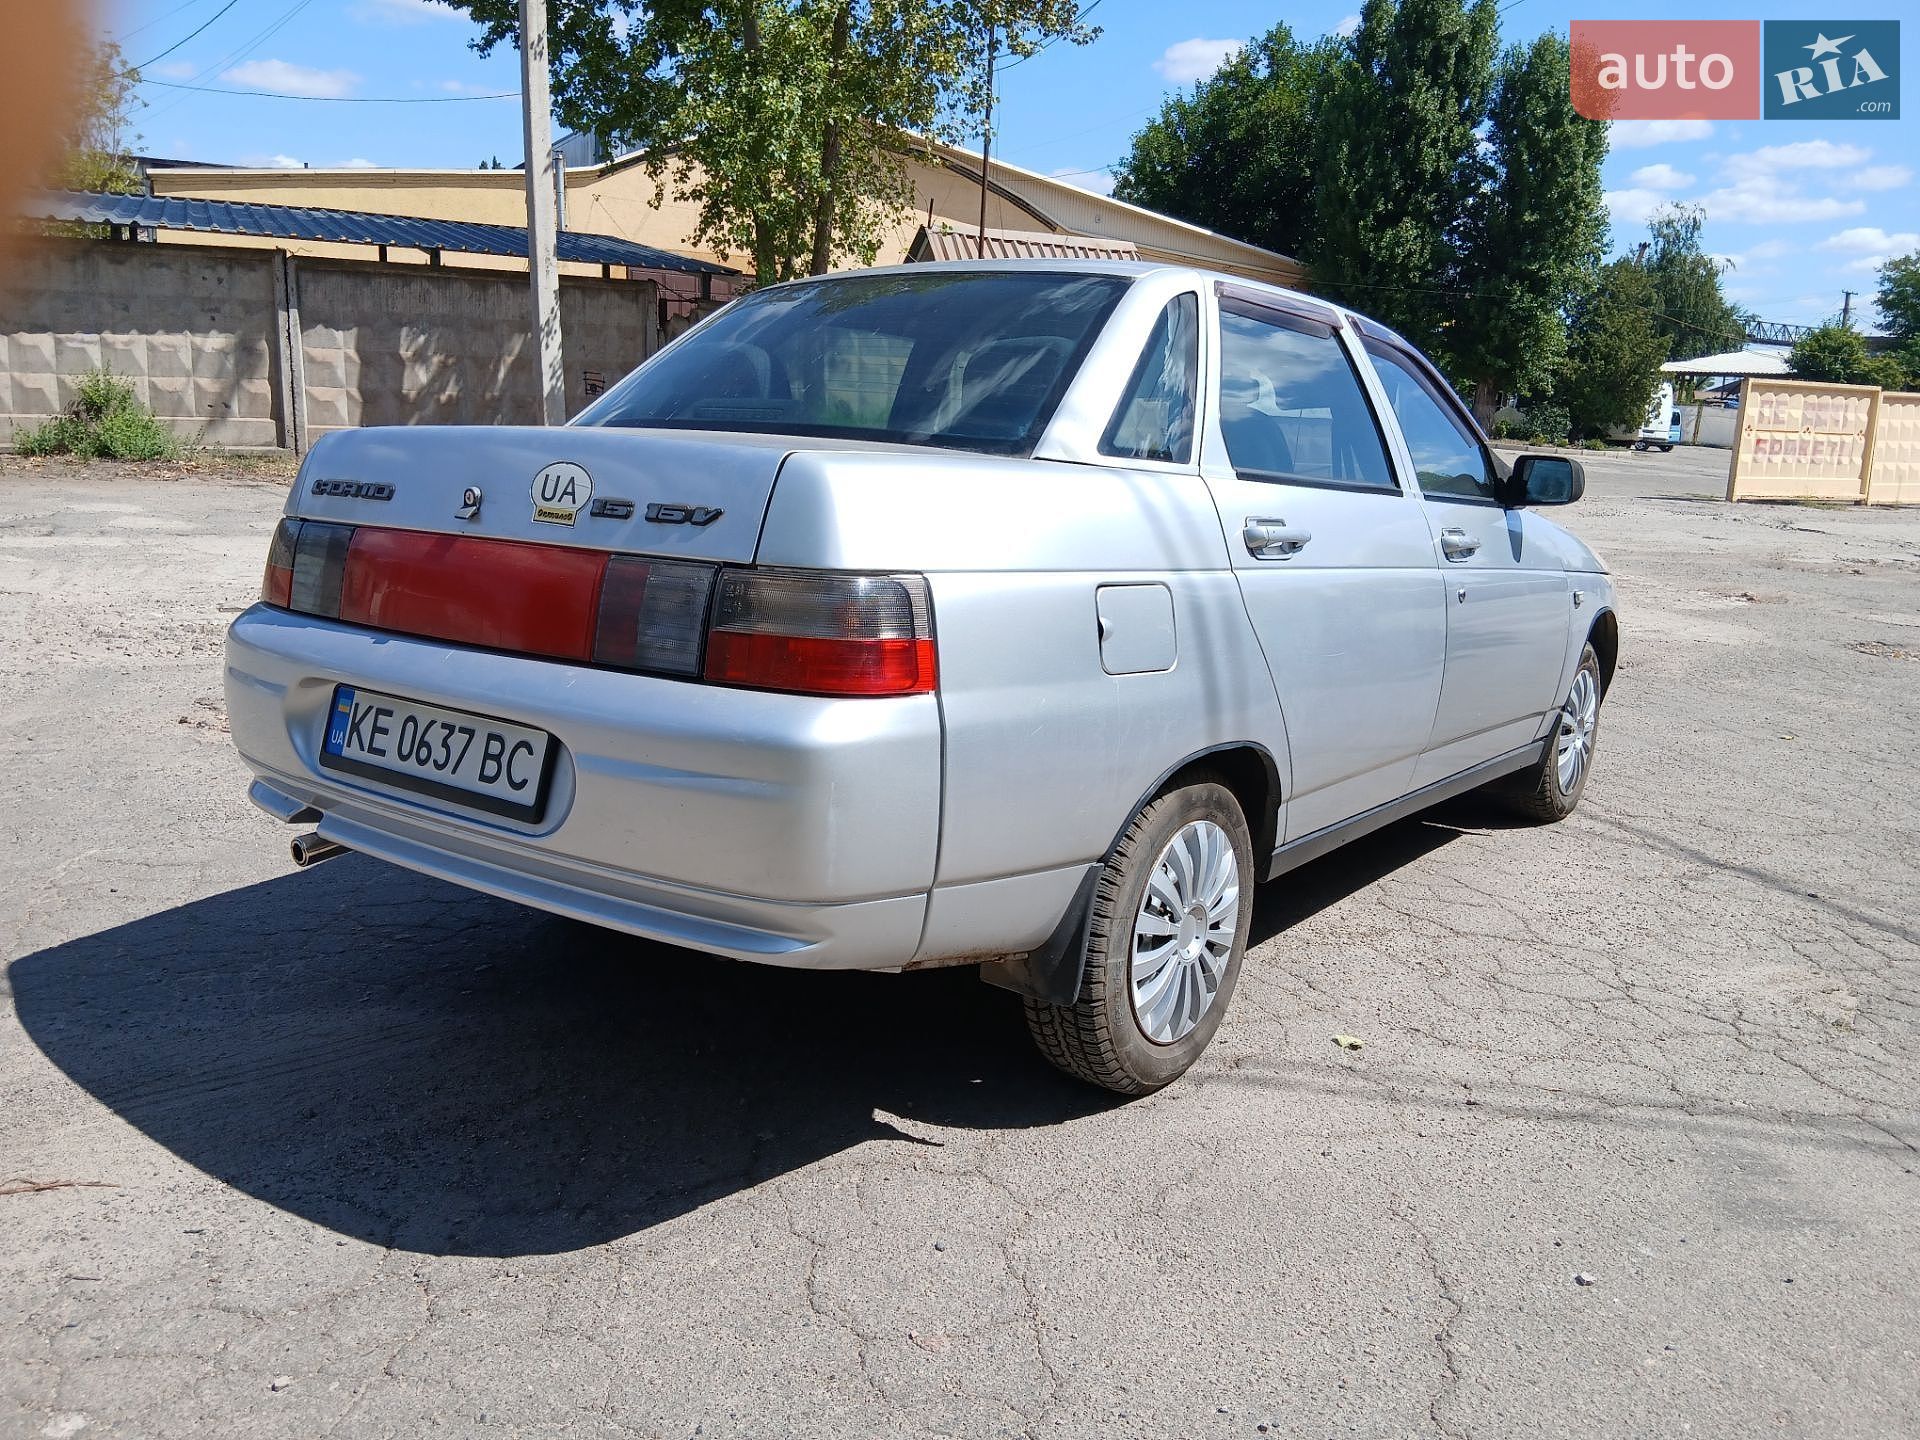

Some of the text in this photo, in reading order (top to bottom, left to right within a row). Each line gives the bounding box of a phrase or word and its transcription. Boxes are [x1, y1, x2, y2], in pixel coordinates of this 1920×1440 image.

[541, 473, 576, 505] UA
[331, 729, 344, 746] UA
[346, 702, 534, 791] KE 0637 BC
